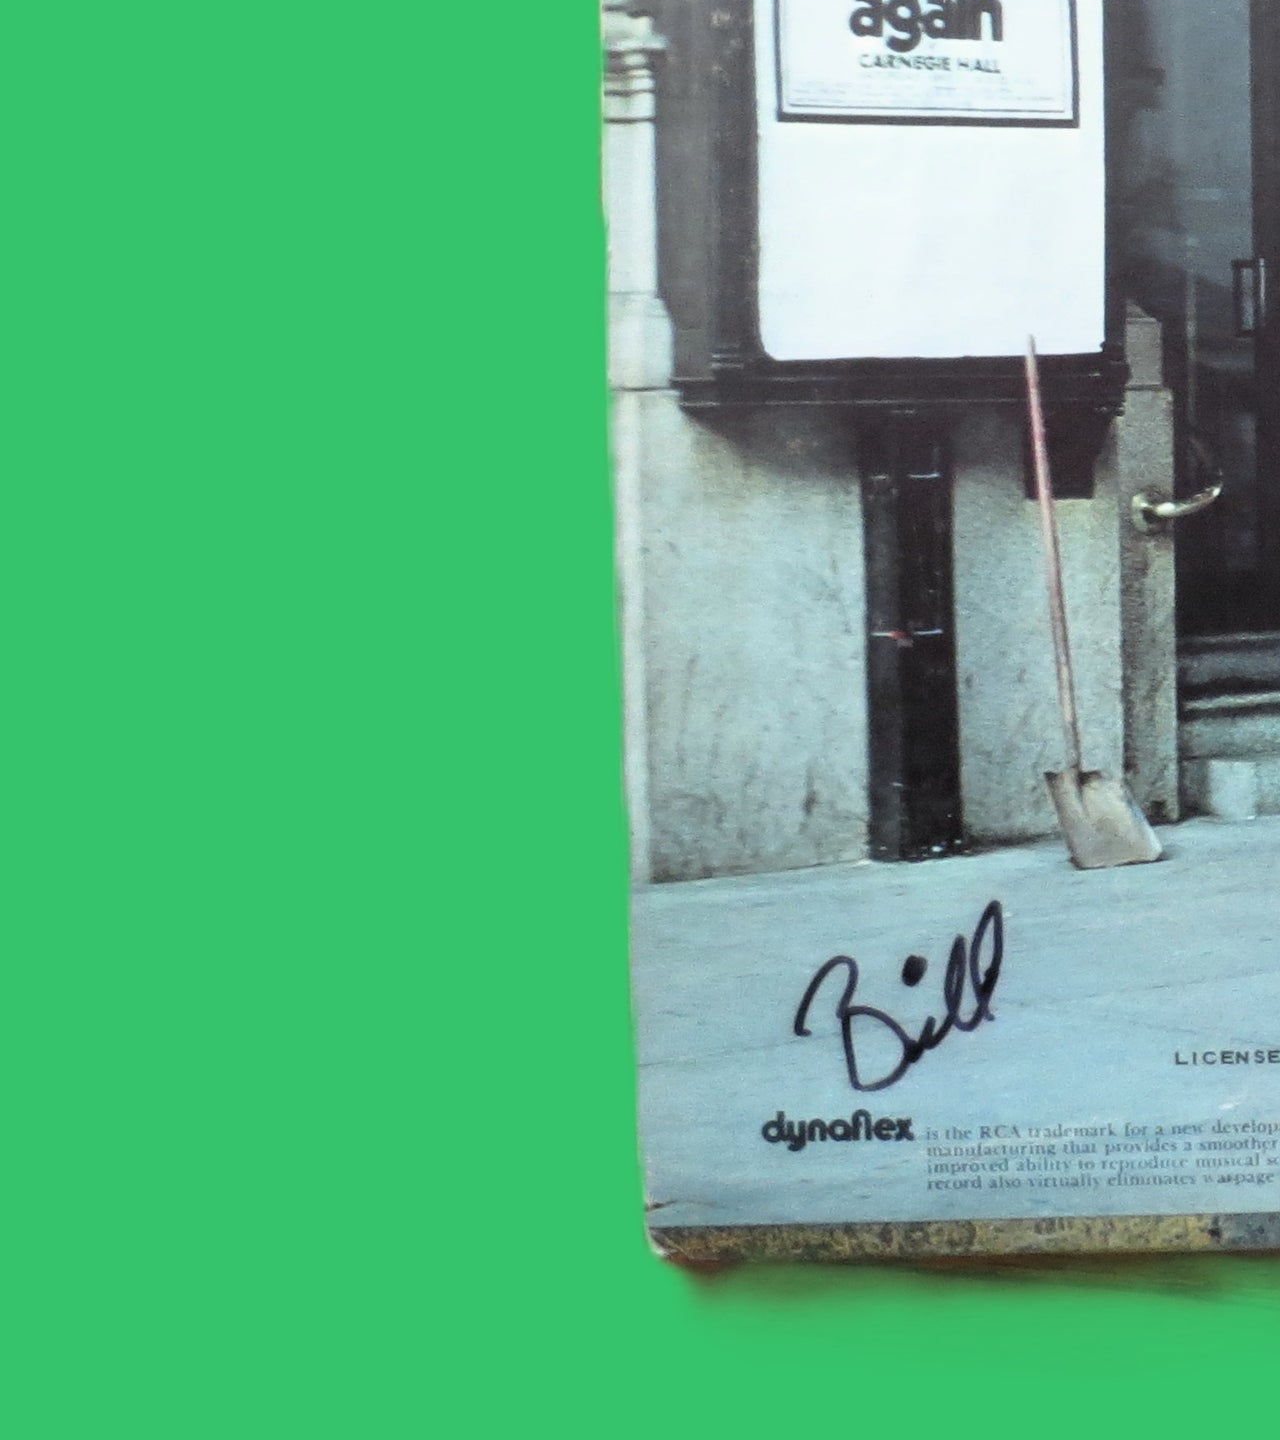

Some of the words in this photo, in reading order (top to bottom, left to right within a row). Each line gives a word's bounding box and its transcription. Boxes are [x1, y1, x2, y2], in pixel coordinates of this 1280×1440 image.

[859, 53, 951, 73] CARNEGIE
[957, 56, 1003, 75] HALL
[794, 899, 1004, 1092] Bill
[761, 1109, 915, 1152] dynaflex
[926, 1126, 939, 1141] is
[945, 1126, 973, 1141] the
[979, 1125, 1021, 1140] RCA
[1027, 1123, 1117, 1139] trademark
[1124, 1121, 1148, 1138] for
[1154, 1125, 1165, 1136] a
[1171, 1124, 1203, 1136] new
[926, 1140, 1056, 1159] manufacturing
[1062, 1139, 1097, 1155] that
[1104, 1136, 1177, 1156] provides
[1184, 1140, 1193, 1151] a
[926, 1159, 1009, 1178] improved
[1015, 1156, 1072, 1174] ability
[1078, 1157, 1095, 1171] to
[1101, 1154, 1188, 1174] reproduce
[1195, 1151, 1260, 1168] musical
[926, 1174, 982, 1191] record
[988, 1173, 1022, 1190] also
[1027, 1172, 1100, 1191] virtually
[1107, 1170, 1197, 1188] eliminates
